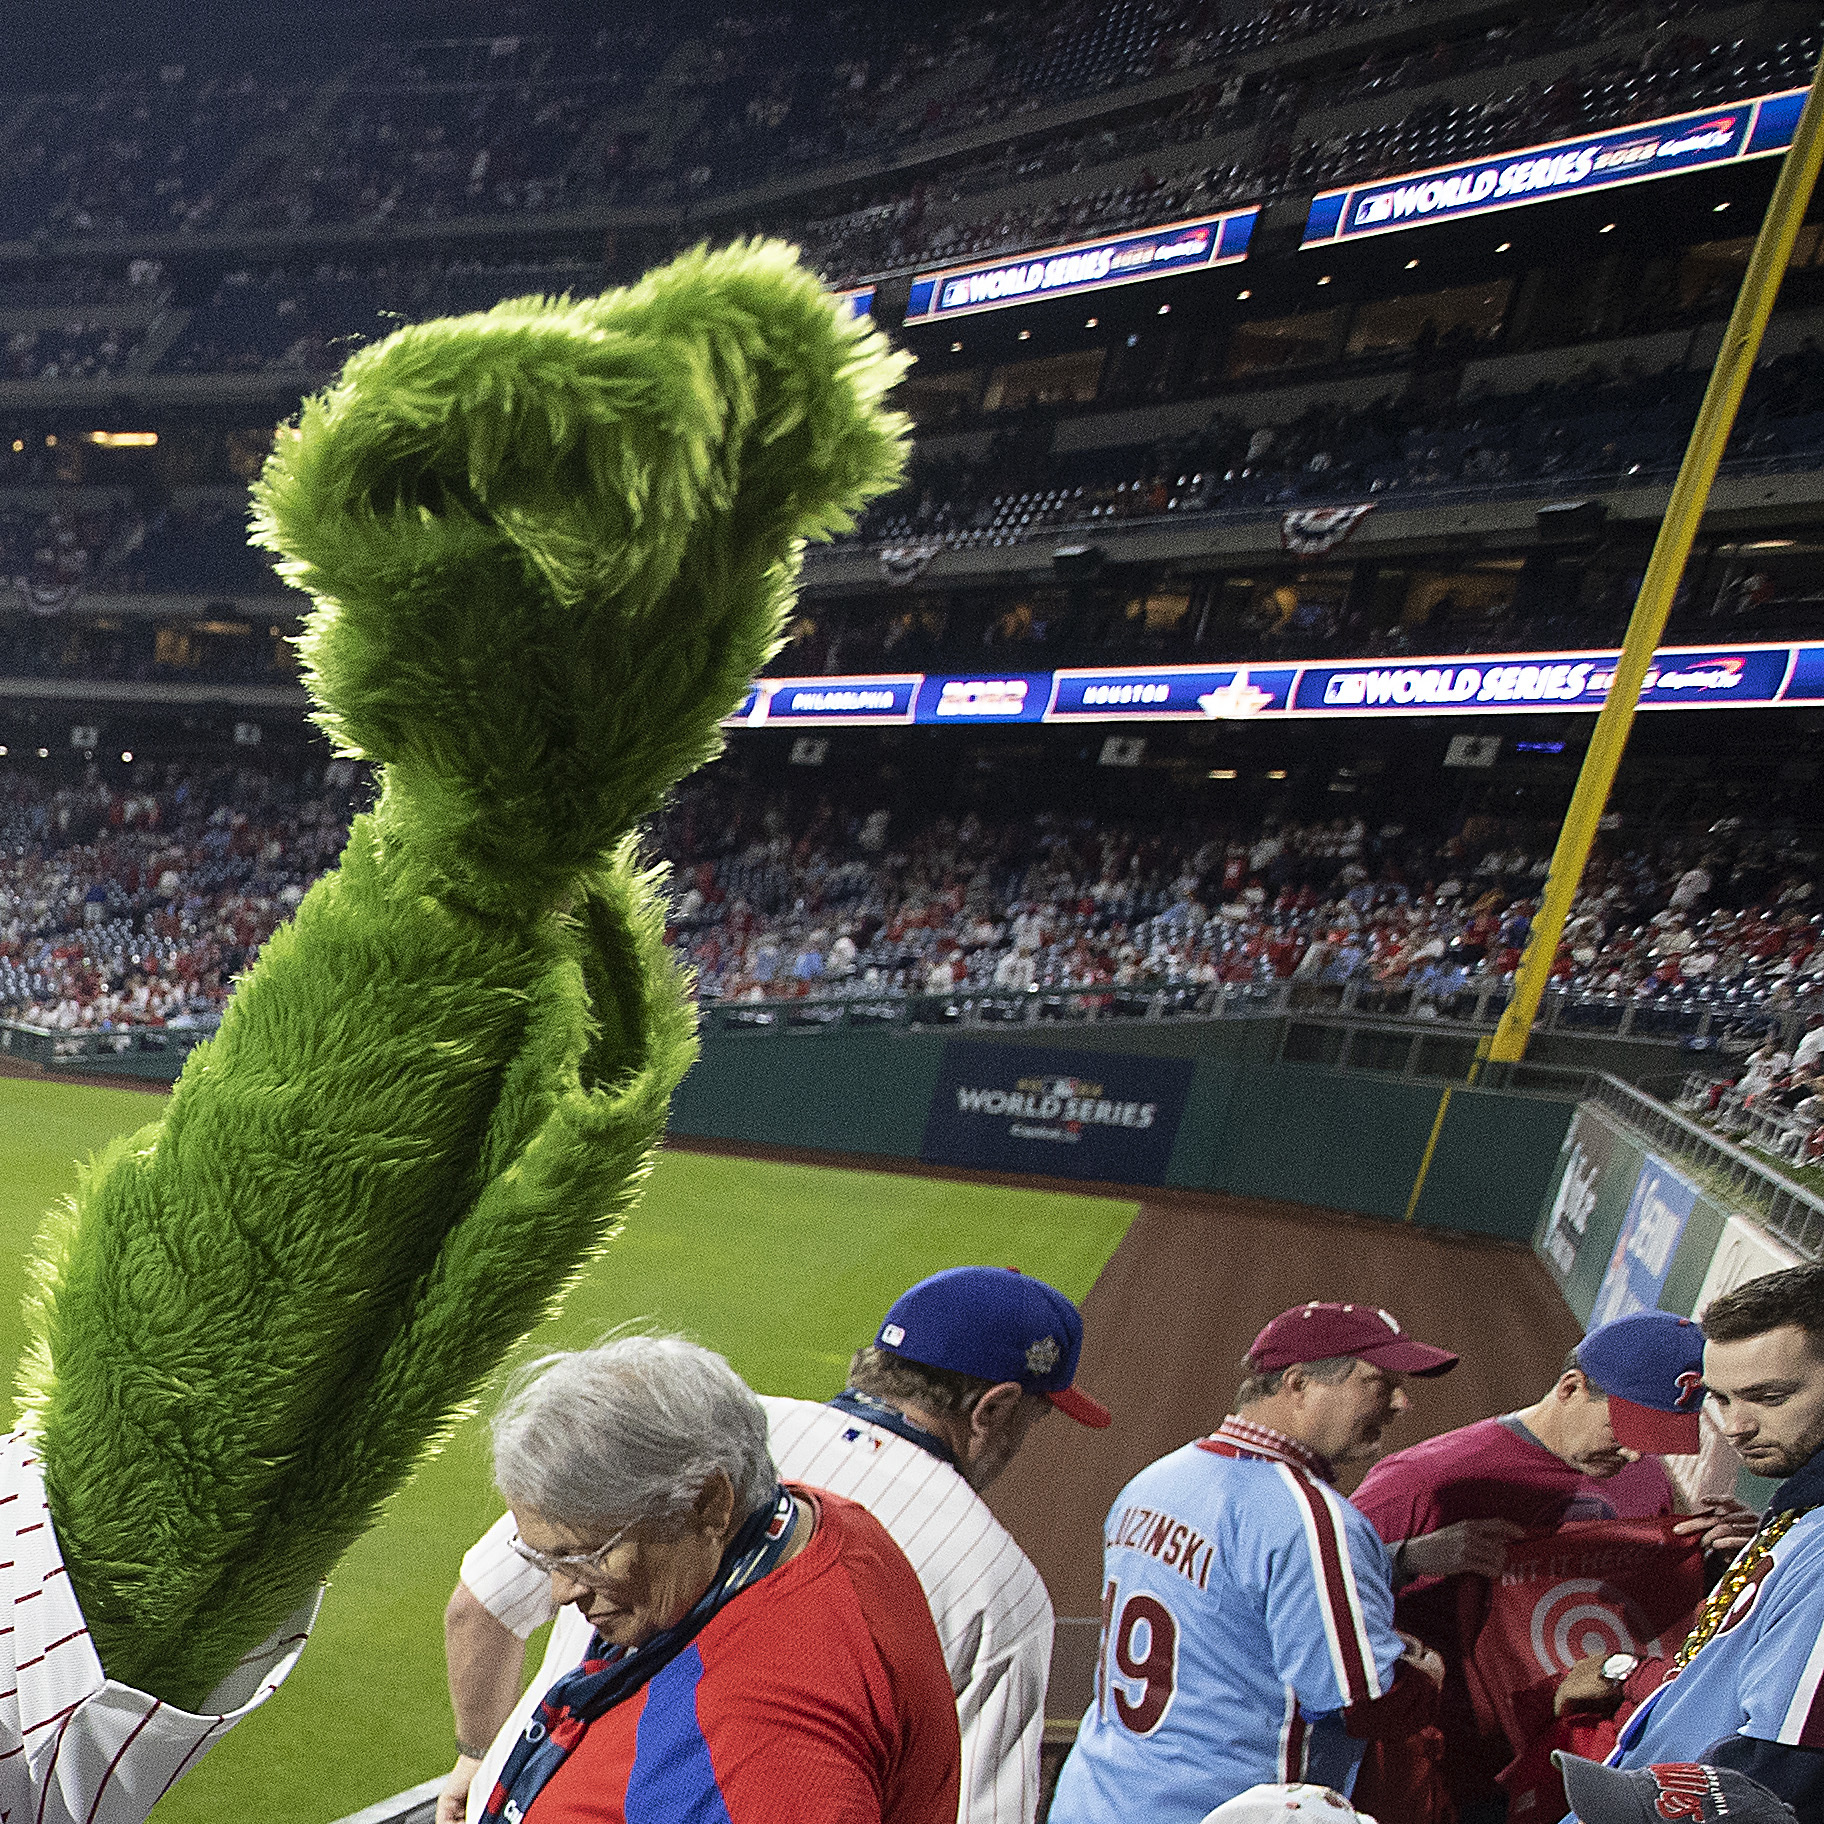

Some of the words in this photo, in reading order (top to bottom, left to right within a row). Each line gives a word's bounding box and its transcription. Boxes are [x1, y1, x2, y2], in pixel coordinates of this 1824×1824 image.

[1393, 171, 1498, 219] WORLD
[1494, 146, 1602, 197] SERIES
[969, 263, 1044, 303] WORLD
[1041, 248, 1114, 289] SERIES
[1083, 685, 1169, 704] HOUSTON
[1365, 669, 1482, 705] WORLD
[1477, 664, 1594, 701] SERIES
[957, 1086, 1061, 1119] WORLD
[1062, 1097, 1158, 1129] SERIES
[1106, 1507, 1215, 1590] UZINSKI
[1098, 1579, 1178, 1736] 19
